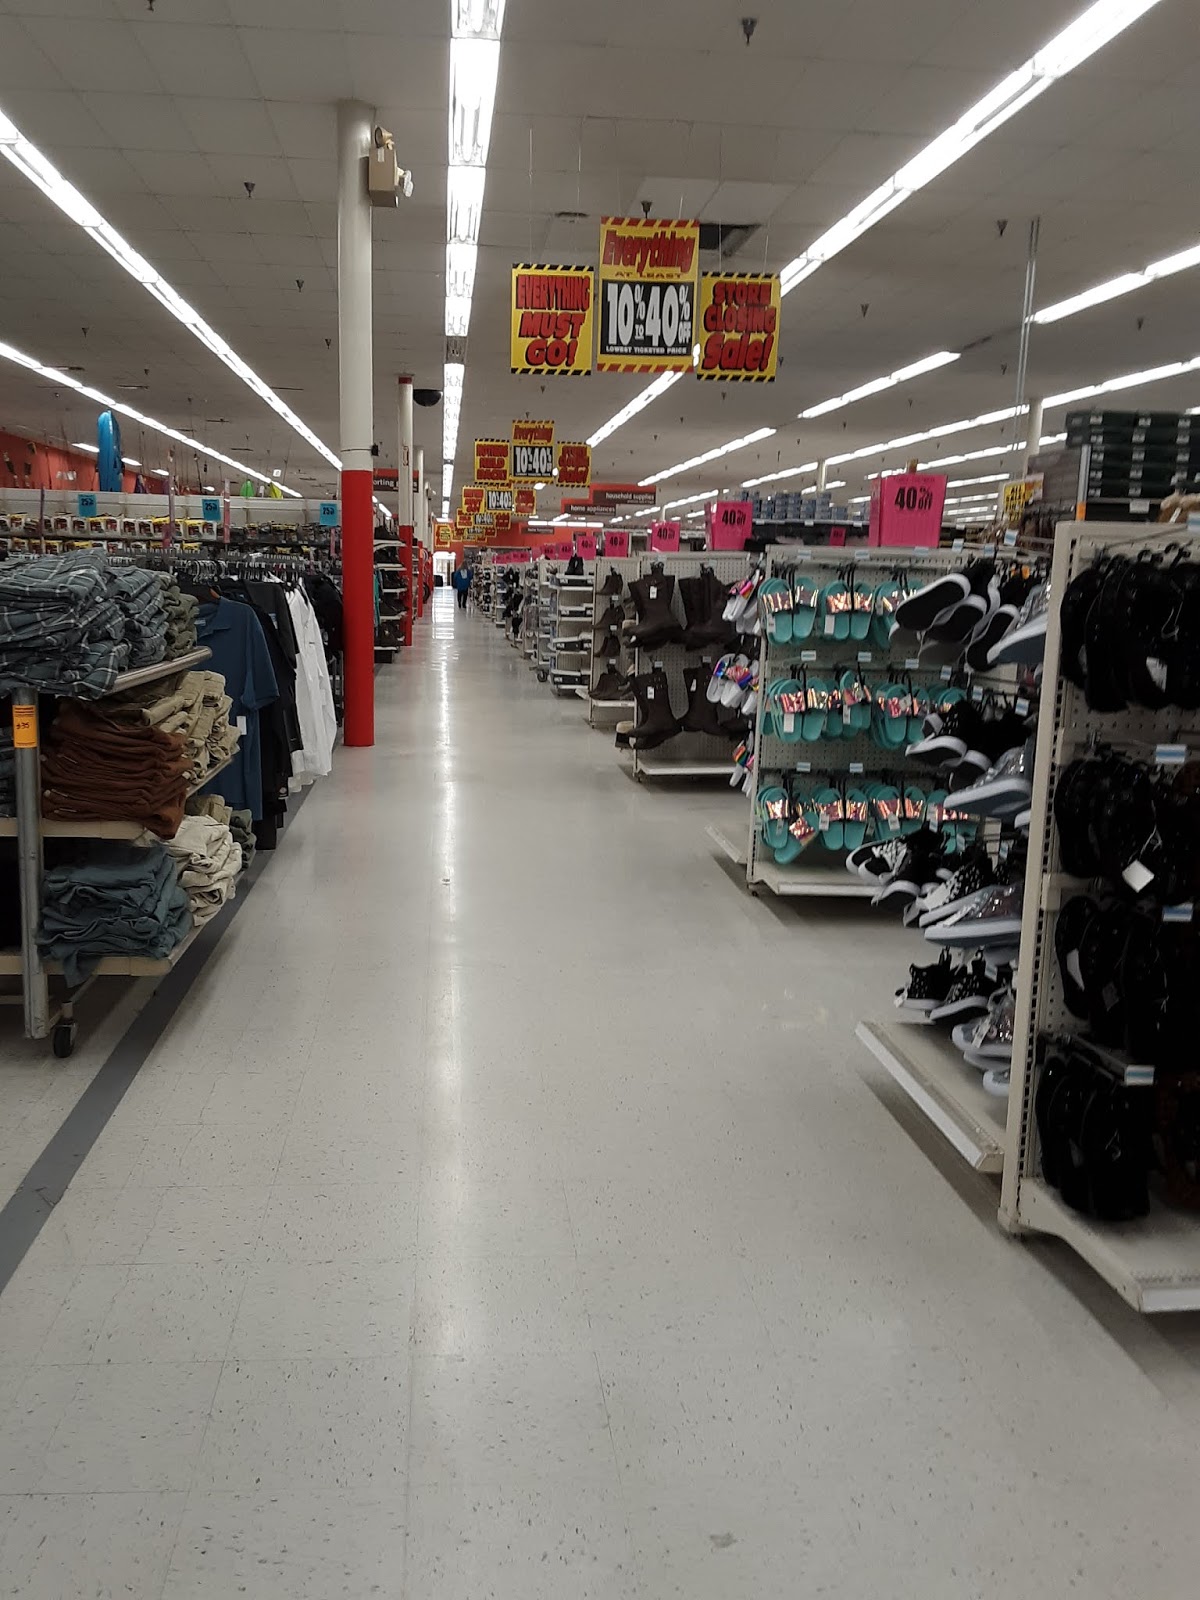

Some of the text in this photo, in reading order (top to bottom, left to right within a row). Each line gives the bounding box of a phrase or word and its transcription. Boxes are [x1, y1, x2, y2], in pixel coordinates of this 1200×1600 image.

[602, 230, 696, 275] Everything
[516, 274, 590, 312] EVERYTHING
[712, 281, 772, 306] STORE
[518, 311, 586, 339] MUST
[634, 324, 645, 339] TO
[678, 321, 692, 343] OFF
[704, 304, 776, 333] CLOSING
[525, 338, 578, 367] GO!
[701, 331, 774, 372] Sale!
[373, 479, 395, 487] orting
[605, 492, 655, 501] household supplies
